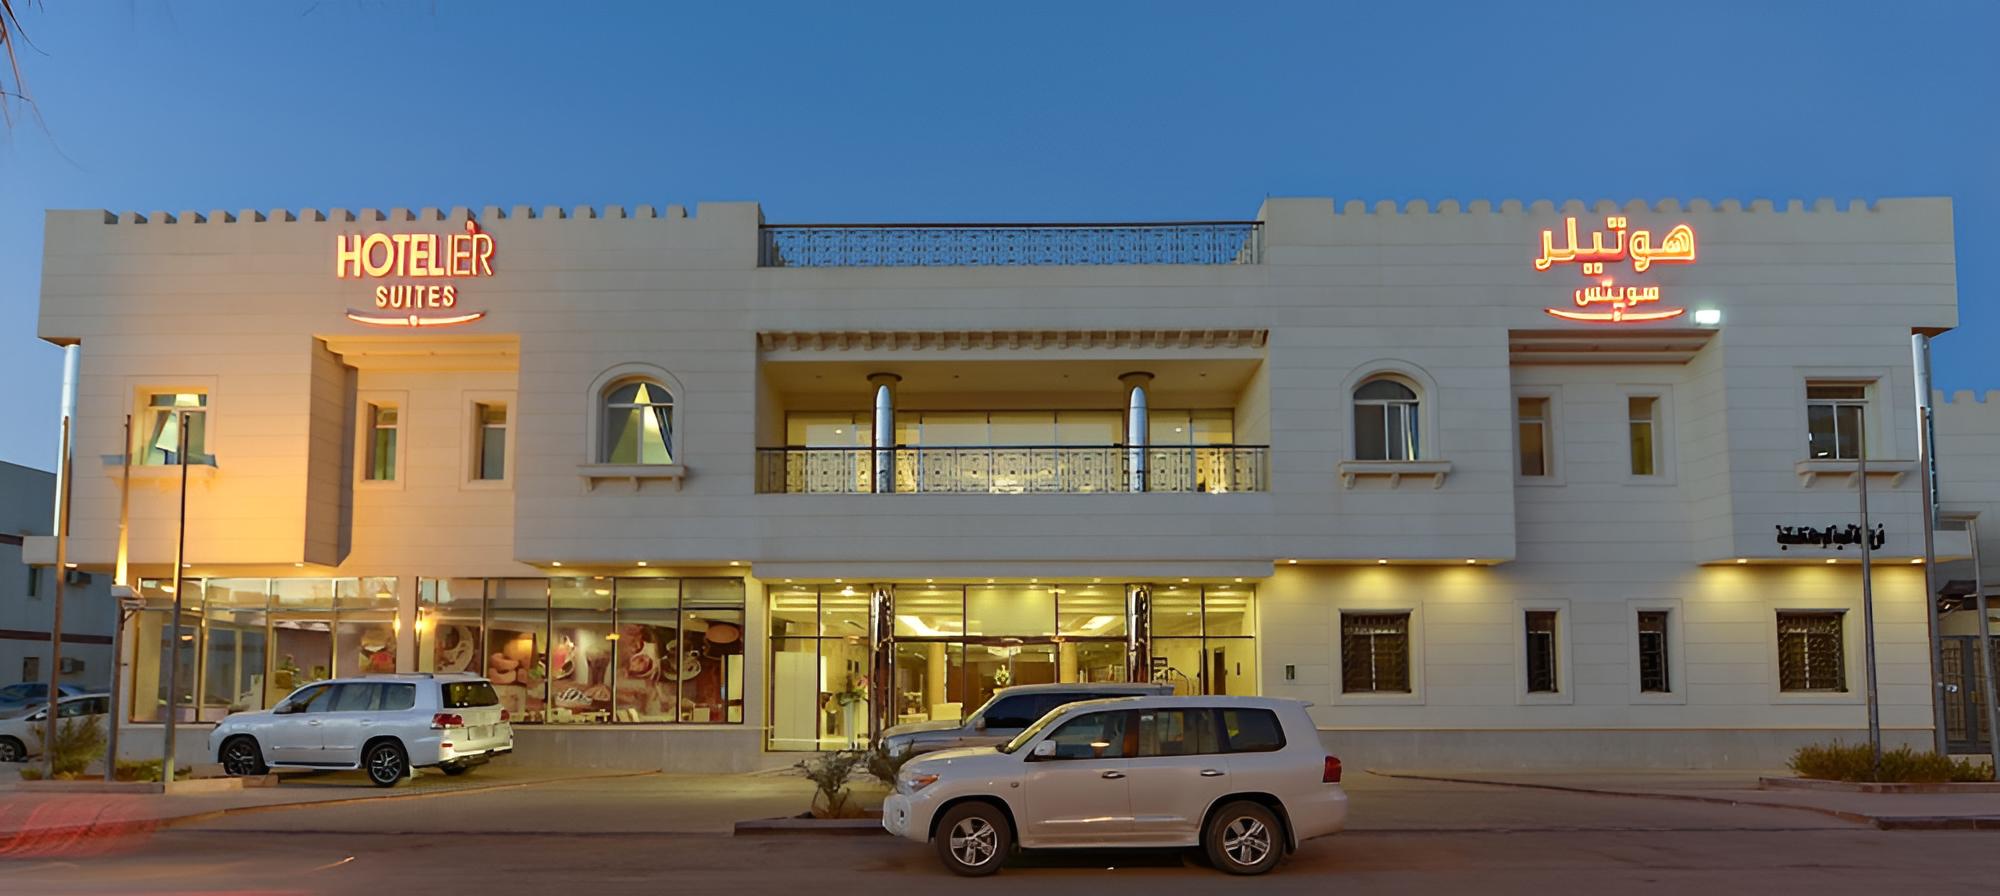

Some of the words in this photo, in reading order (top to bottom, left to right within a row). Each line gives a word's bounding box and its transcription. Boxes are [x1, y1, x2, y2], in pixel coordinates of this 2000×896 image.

[1535, 216, 1696, 274] هوتيلر
[375, 285, 457, 309] SUITES
[1575, 278, 1660, 309] سويتس
